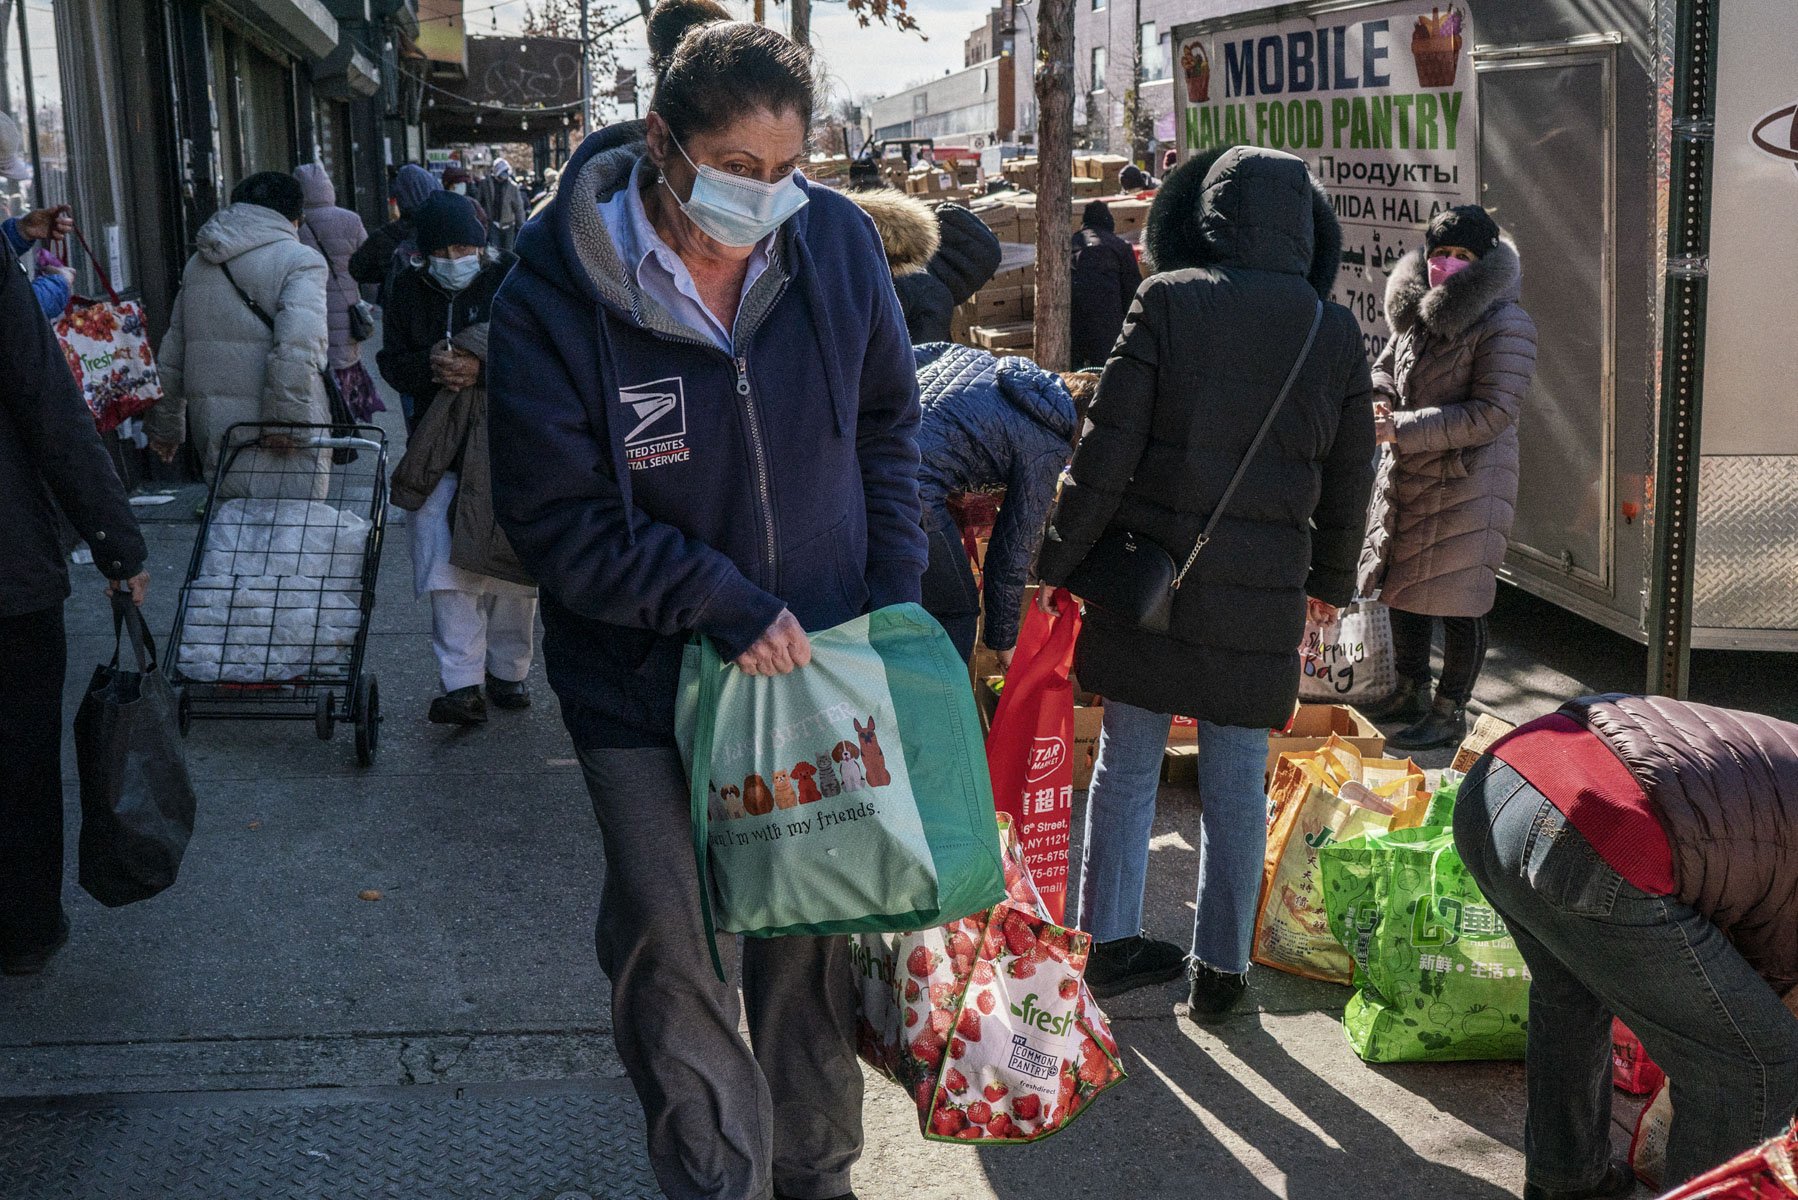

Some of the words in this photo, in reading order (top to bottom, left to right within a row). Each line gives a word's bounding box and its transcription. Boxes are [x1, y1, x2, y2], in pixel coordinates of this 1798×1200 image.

[1223, 19, 1391, 98] MOBILE
[1185, 102, 1250, 149] HALAL
[1256, 97, 1324, 149] FOOD
[1331, 91, 1463, 150] PANTRY
[1319, 156, 1458, 187] Продукты
[1382, 197, 1451, 225] HALA
[650, 439, 685, 454] STATES
[650, 451, 690, 467] SERVICE
[727, 829, 750, 846] I'm
[751, 823, 782, 841] with
[786, 818, 812, 836] my
[816, 802, 881, 831] friends.
[1036, 818, 1069, 833] Street,
[1021, 993, 1074, 1037] fresh
[1011, 1057, 1048, 1078] PANTRY
[1015, 1045, 1055, 1067] COMMON
[1020, 1080, 1056, 1095] freshdirect
